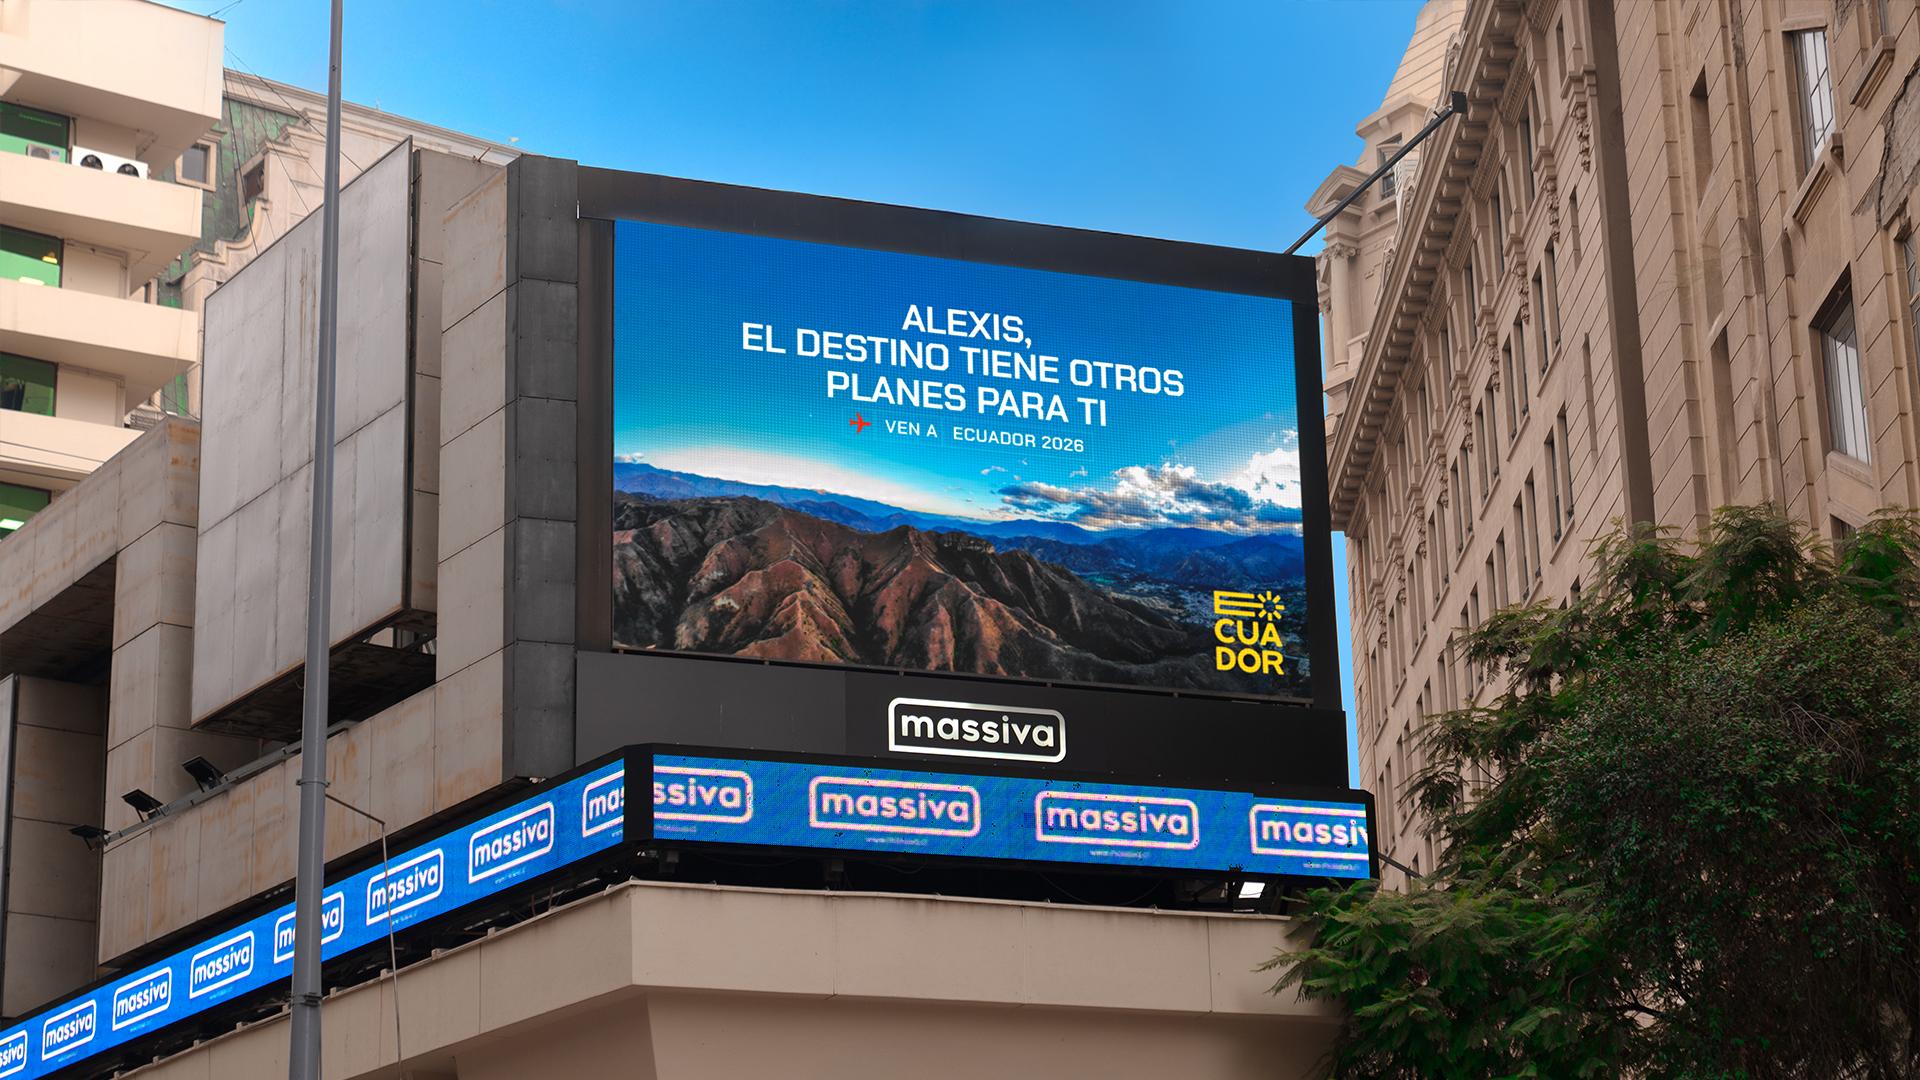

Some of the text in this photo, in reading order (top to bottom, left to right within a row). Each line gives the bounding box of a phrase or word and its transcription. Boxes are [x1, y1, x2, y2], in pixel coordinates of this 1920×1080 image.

[901, 304, 1033, 349] ALEXIS,
[742, 322, 1185, 397] EL DESTINO TIENE OTROS
[827, 370, 1107, 427] PLANES PARA TI
[885, 419, 1084, 453] VEN A ECUADOR 2026
[1214, 618, 1283, 648] CUA
[1215, 646, 1285, 675] DOR
[901, 714, 1054, 747] massiva
[821, 792, 969, 823] massiva
[1046, 805, 1189, 836] massiva
[474, 818, 548, 868] massiva
[371, 864, 439, 910] massiva
[194, 945, 250, 985] massiva
[116, 981, 168, 1017] massiva
[46, 1012, 93, 1048] massiva
